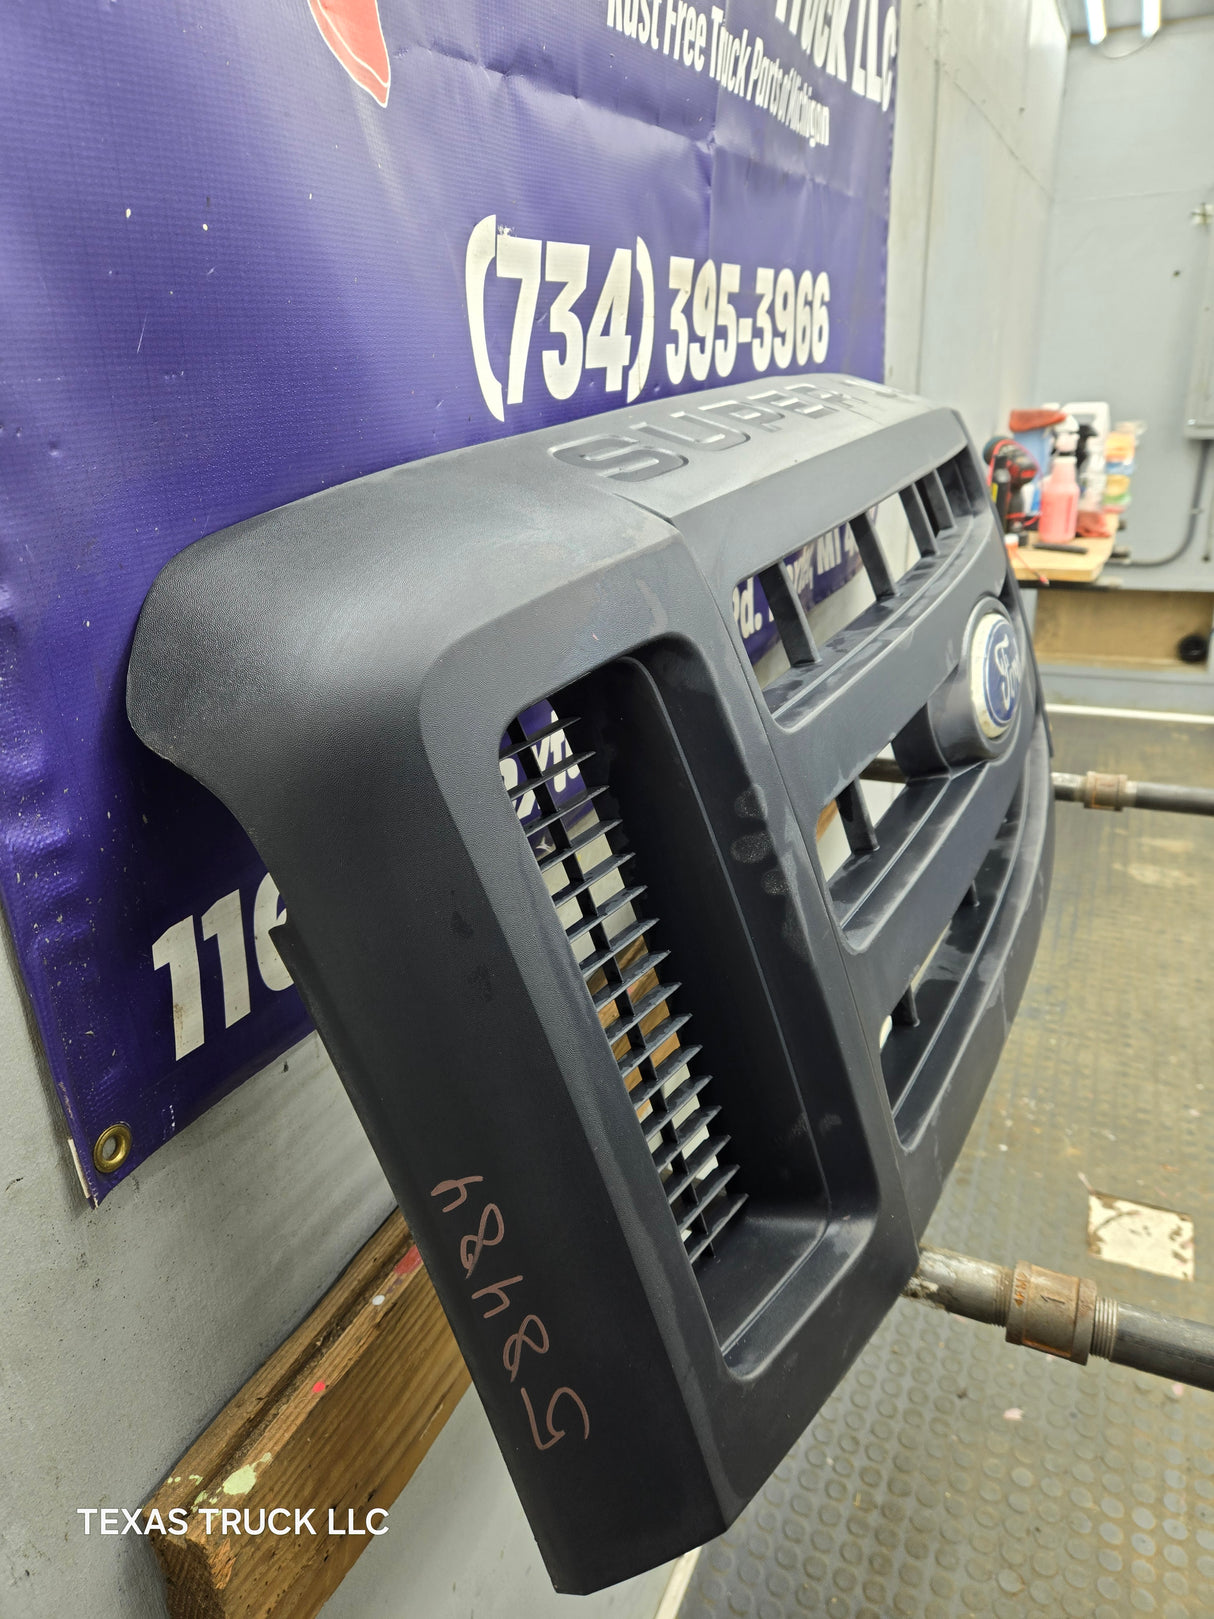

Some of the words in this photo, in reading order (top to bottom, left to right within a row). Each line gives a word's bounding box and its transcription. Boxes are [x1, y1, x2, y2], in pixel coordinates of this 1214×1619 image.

[662, 0, 707, 72] Free
[709, 5, 752, 97] Truck
[465, 214, 654, 422] (734)
[666, 255, 830, 385] 395-3966
[547, 382, 868, 482] SUPER
[430, 1174, 591, 1451] 58484
